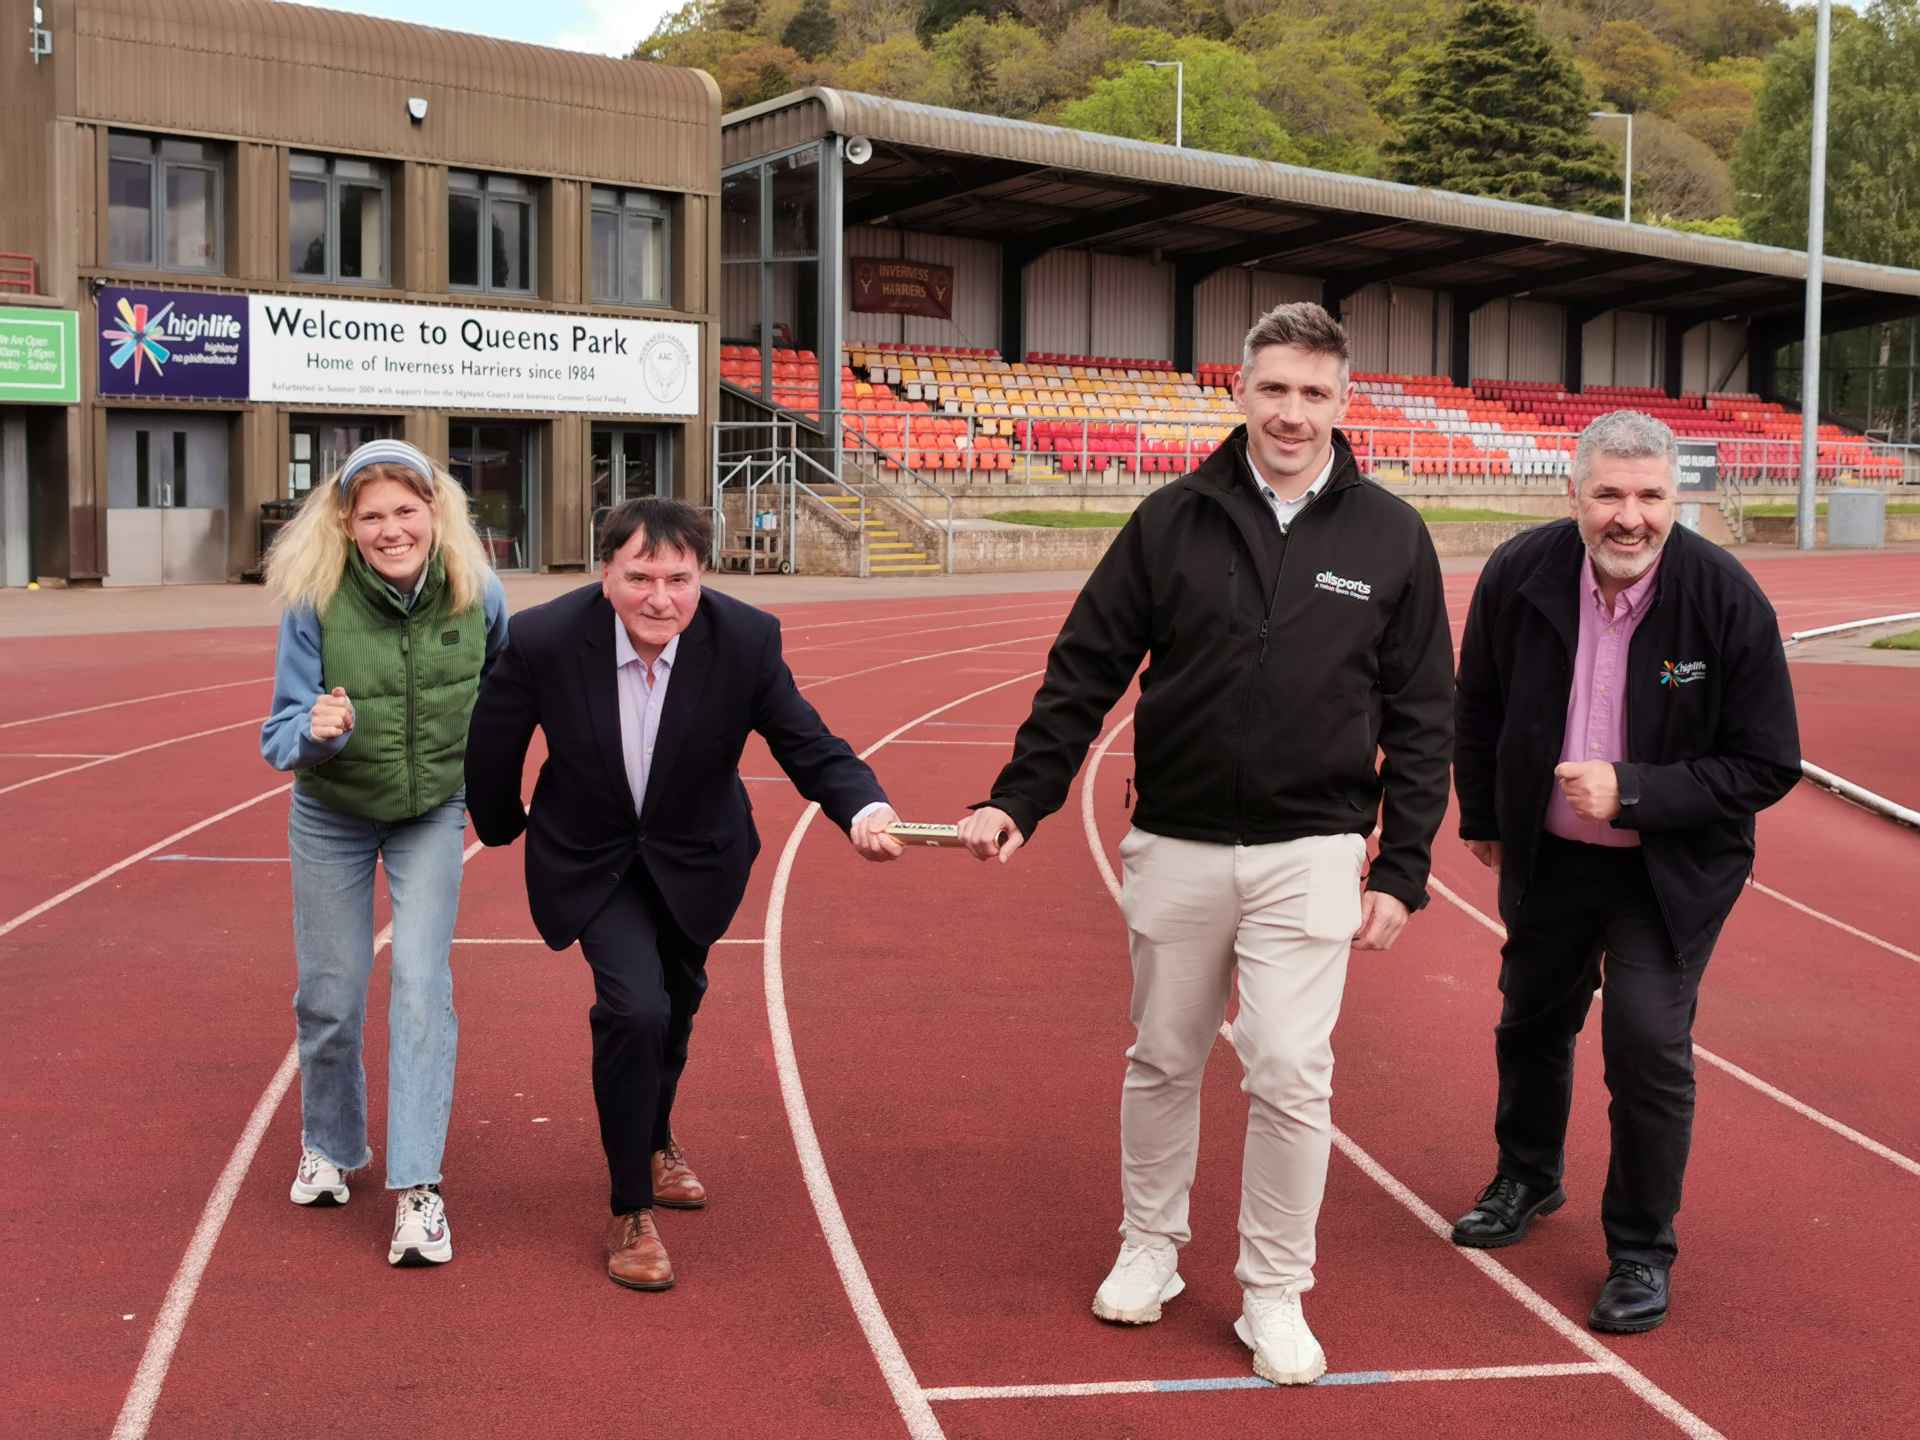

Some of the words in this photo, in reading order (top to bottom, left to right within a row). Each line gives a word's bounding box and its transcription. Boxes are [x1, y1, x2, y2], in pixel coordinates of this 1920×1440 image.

[167, 311, 241, 341] highlife
[265, 305, 404, 343] Welcome
[419, 320, 447, 345] to
[461, 317, 559, 351] Queens
[572, 325, 628, 355] Park
[306, 351, 354, 372] Home
[361, 354, 378, 372] of
[384, 356, 455, 375] Inverness
[461, 360, 522, 378] Harriers
[528, 364, 562, 380] since
[568, 365, 595, 381] 1984
[1316, 571, 1371, 595] allsports
